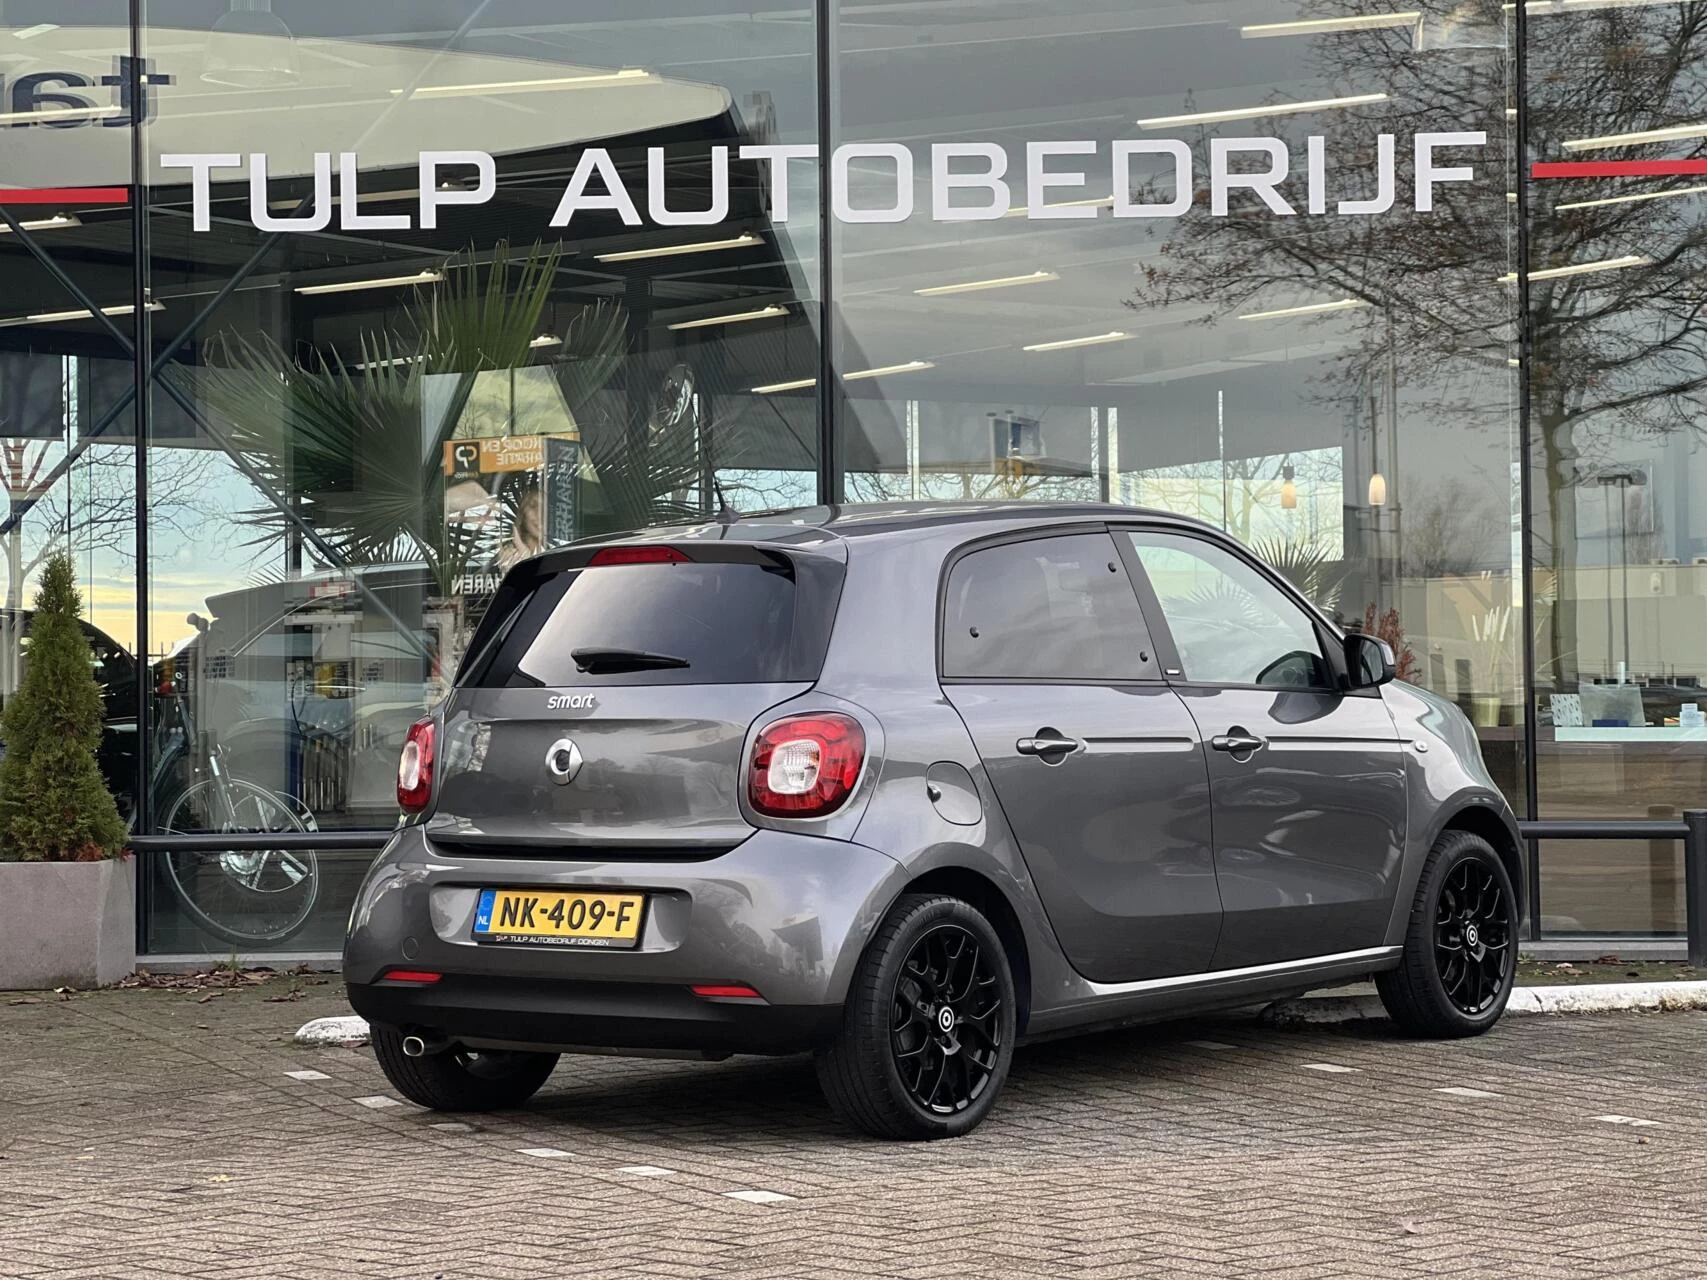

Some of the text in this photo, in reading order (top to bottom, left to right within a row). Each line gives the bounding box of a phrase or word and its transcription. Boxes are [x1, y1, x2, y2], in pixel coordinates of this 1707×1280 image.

[160, 130, 1487, 233] TULP AUTOBEDRIJF
[547, 693, 595, 710] smart
[478, 915, 489, 925] NL
[500, 897, 634, 931] NK-409-F
[510, 935, 529, 943] TULP
[529, 936, 577, 945] AUTOBEDRIJF
[578, 938, 610, 946] DONGEN
